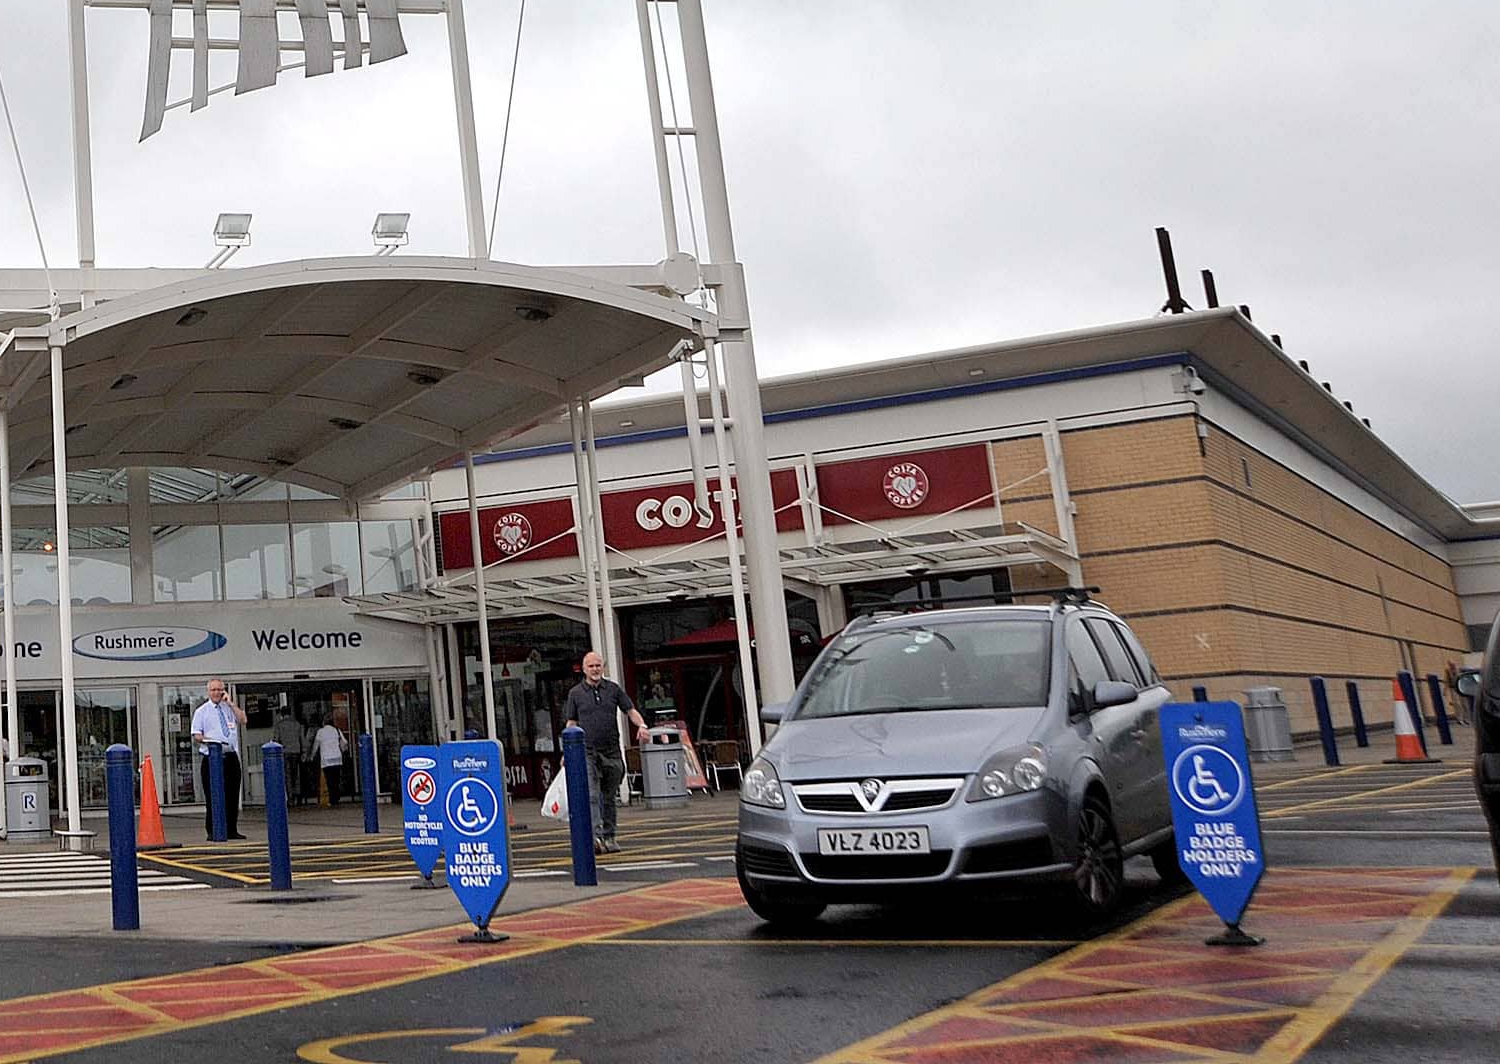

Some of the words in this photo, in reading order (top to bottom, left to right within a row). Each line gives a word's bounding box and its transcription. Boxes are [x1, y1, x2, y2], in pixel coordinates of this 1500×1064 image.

[888, 465, 917, 478] COSTA
[498, 514, 522, 527] COSTA
[94, 634, 175, 649] Rushmere
[252, 630, 363, 651] Welcome
[504, 765, 528, 786] OSTA
[667, 762, 677, 776] R
[24, 795, 36, 809] R
[1195, 823, 1235, 836] BLUE
[459, 842, 489, 853] BLUE
[827, 833, 864, 851] VLZ
[869, 832, 920, 850] 4023
[1189, 836, 1245, 849] BADGE
[455, 854, 495, 865] BADGE
[1183, 850, 1256, 864] HOLDERS
[449, 865, 502, 876] HOLDERS
[1200, 863, 1242, 877] ONLY
[460, 876, 492, 887] ONLY
